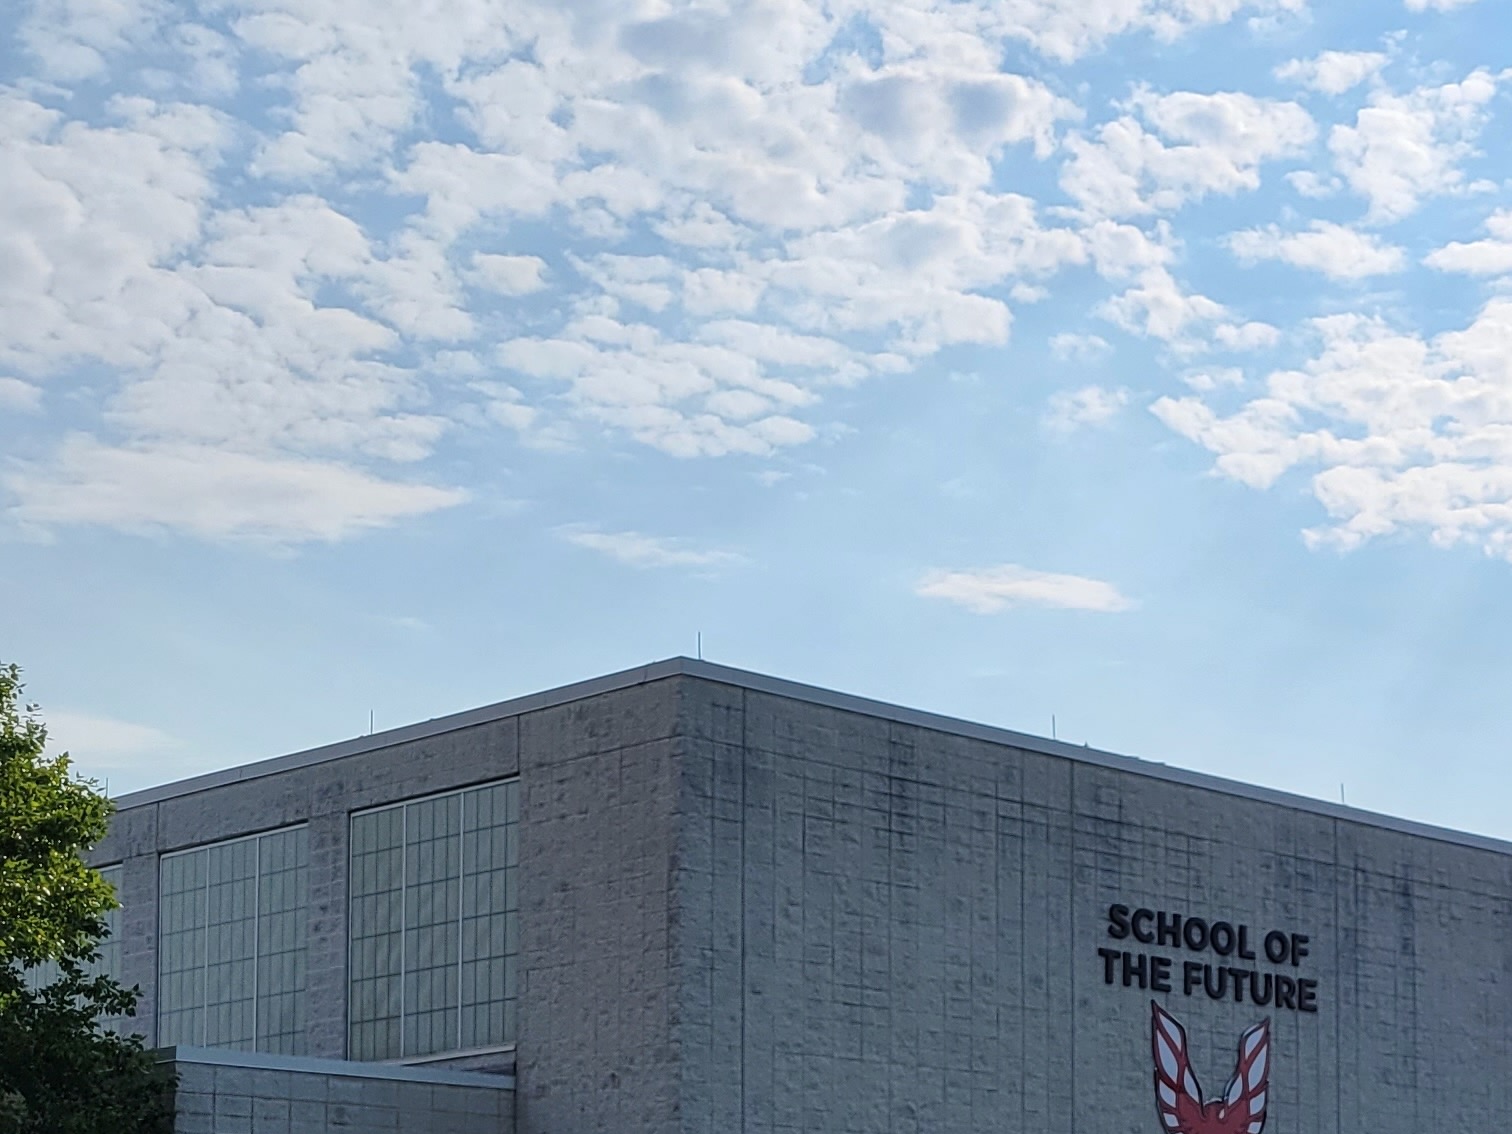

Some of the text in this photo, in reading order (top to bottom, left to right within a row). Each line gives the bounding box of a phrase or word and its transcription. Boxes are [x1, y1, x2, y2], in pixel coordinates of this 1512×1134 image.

[1107, 904, 1310, 967] SCHOOL OF
[1098, 948, 1318, 1012] THE FUTURE
